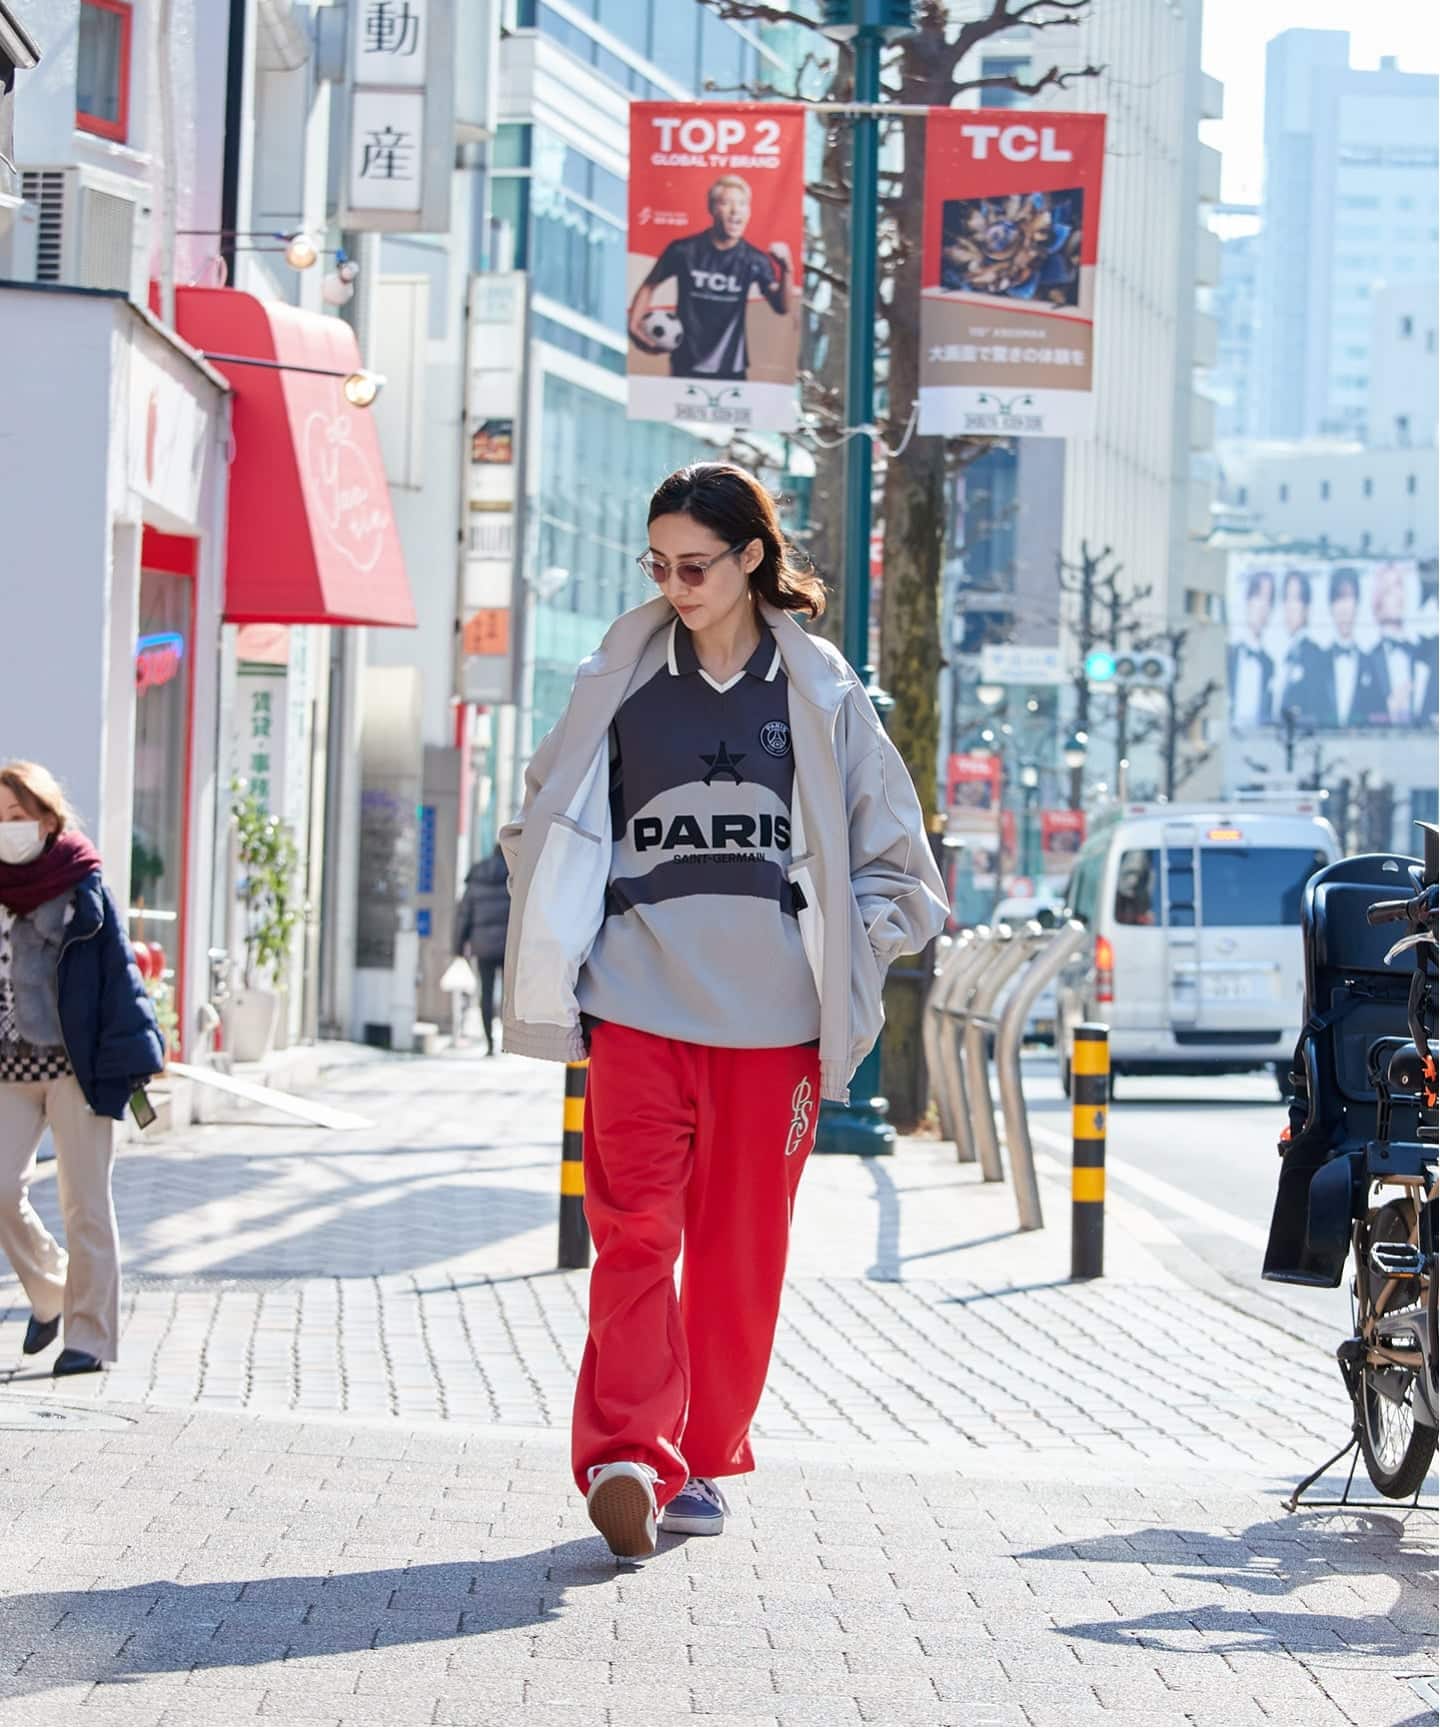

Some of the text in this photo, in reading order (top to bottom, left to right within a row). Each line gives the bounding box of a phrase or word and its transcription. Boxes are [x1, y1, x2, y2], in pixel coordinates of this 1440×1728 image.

[652, 117, 780, 154] TOP 2
[962, 125, 1072, 162] TCL
[651, 152, 781, 169] GLOBAL TV BRAND
[690, 269, 742, 293] TCL
[633, 813, 792, 852] PARIS
[673, 851, 766, 866] SAINT-GERMAIN
